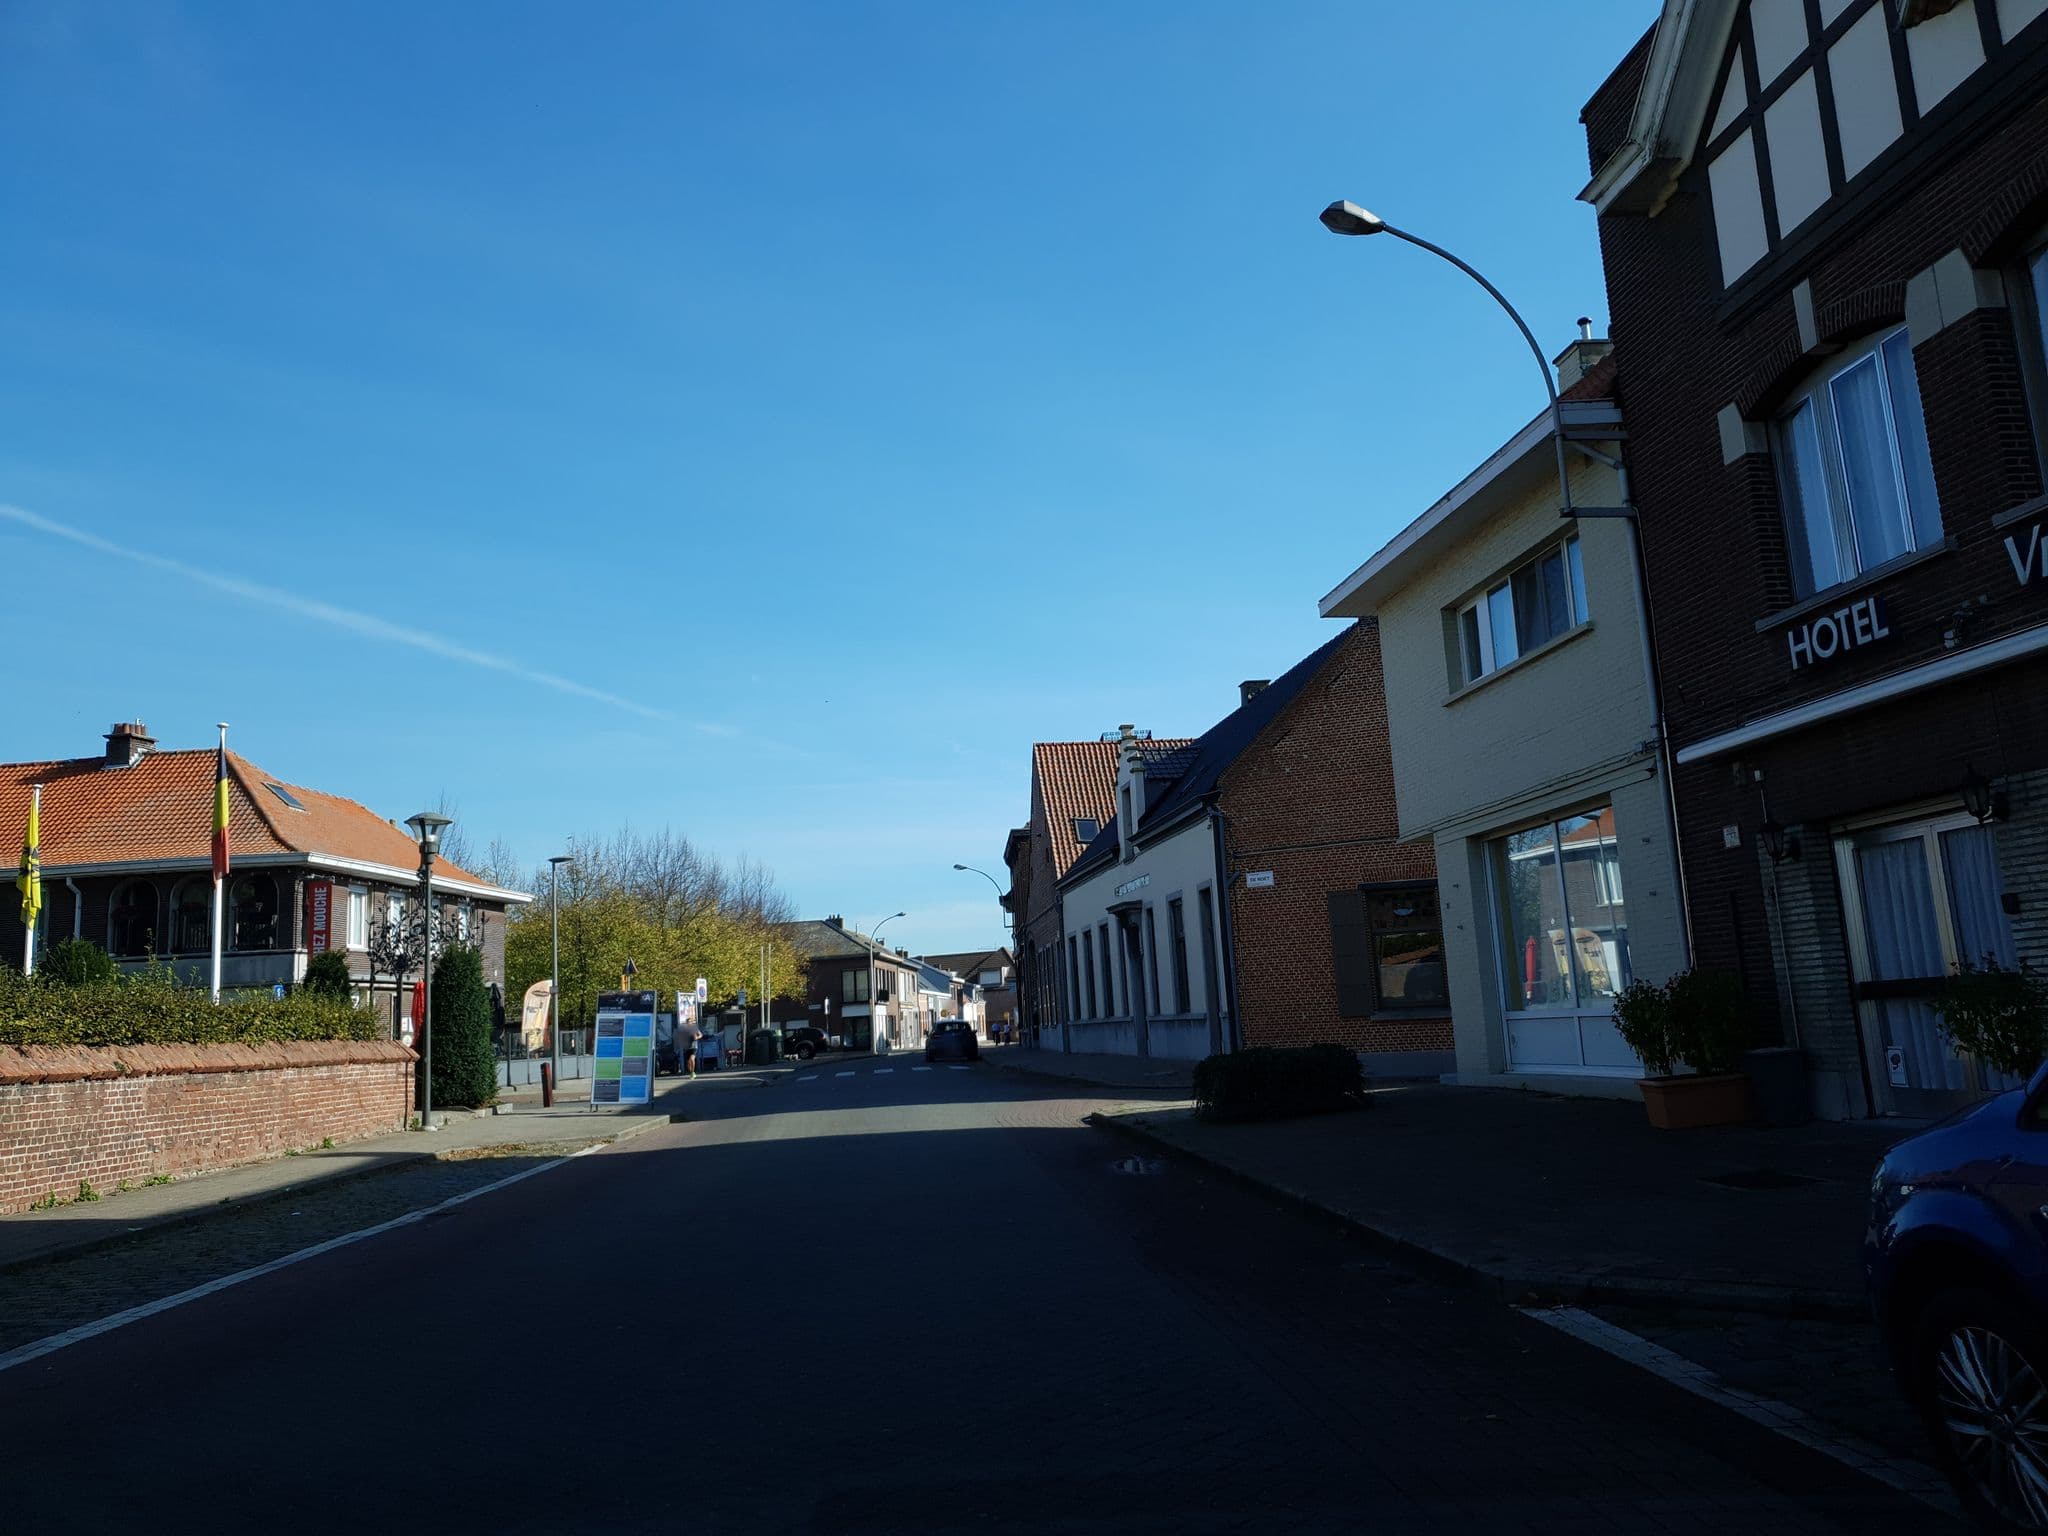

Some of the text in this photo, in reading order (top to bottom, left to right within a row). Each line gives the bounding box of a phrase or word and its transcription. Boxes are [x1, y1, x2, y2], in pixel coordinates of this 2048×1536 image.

[1787, 597, 1890, 670] HOTEL
[313, 887, 327, 954] HEZ MOUCHE
